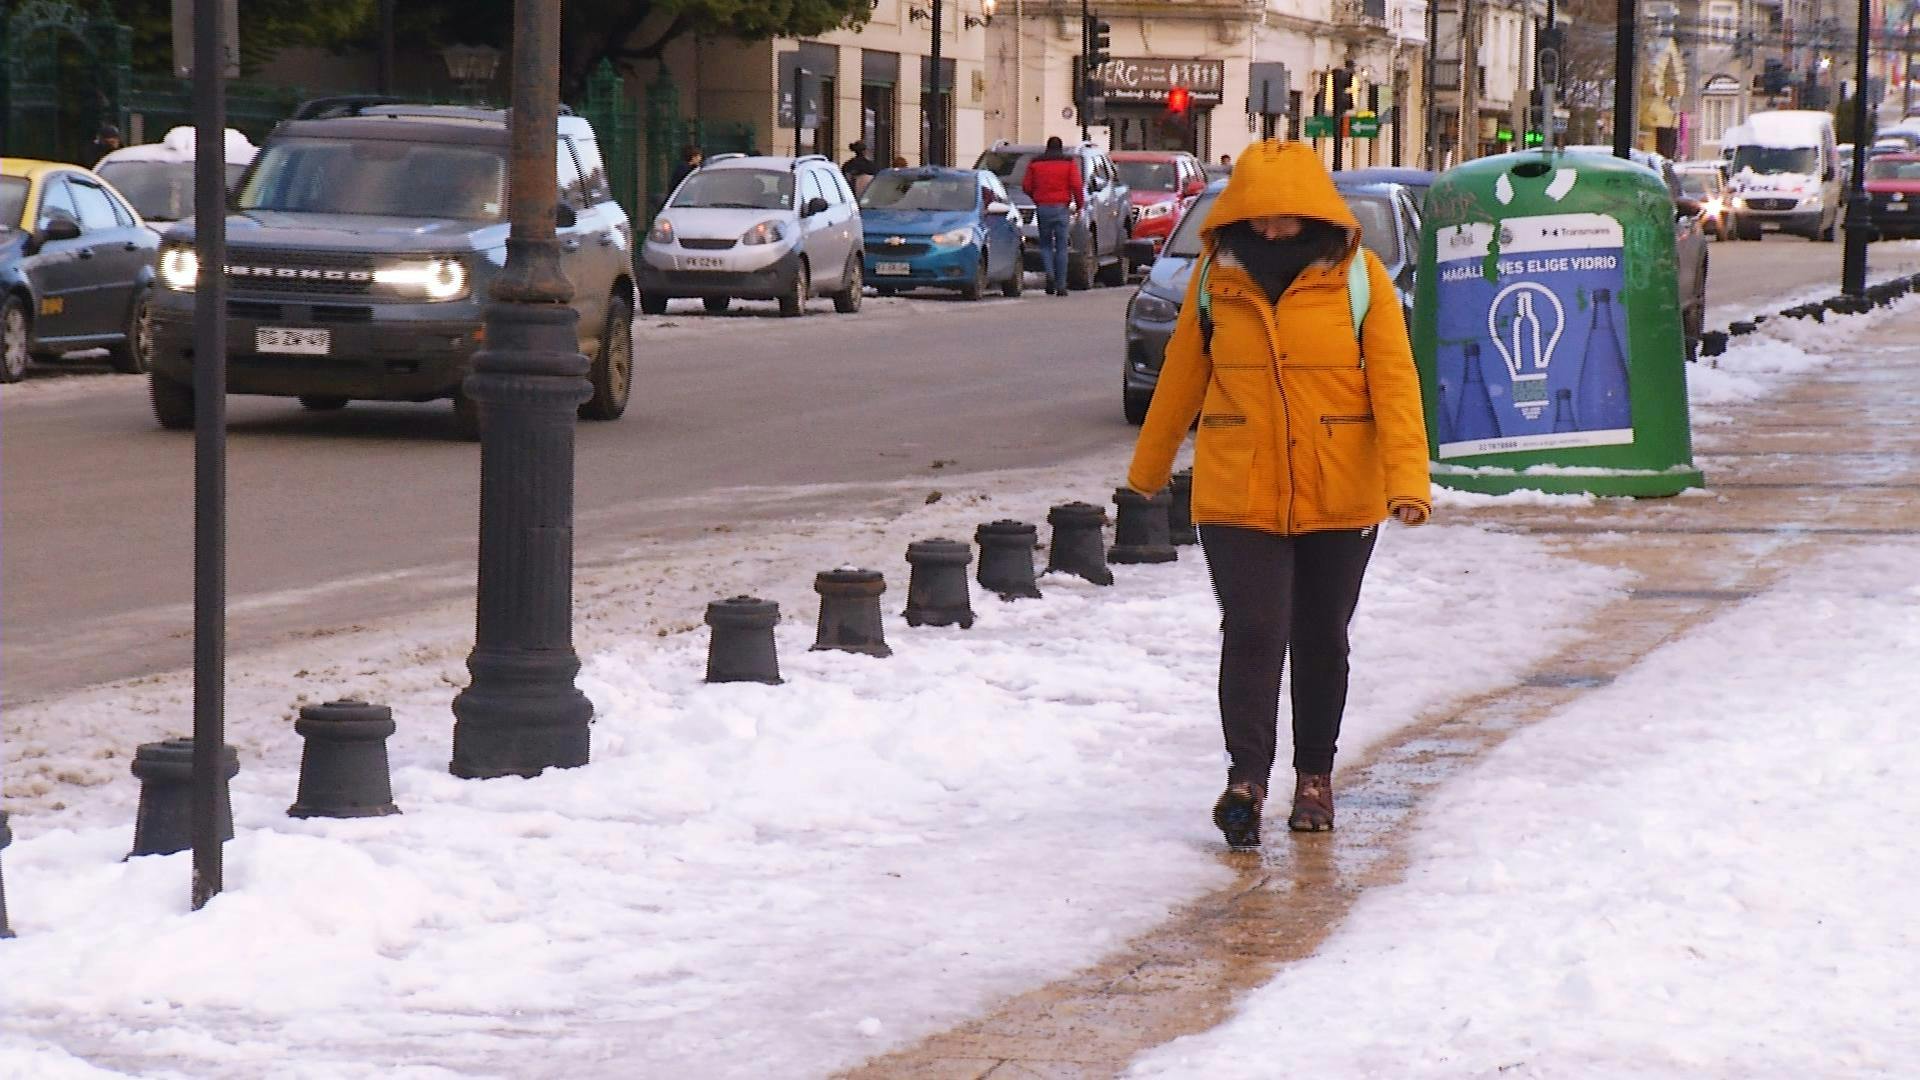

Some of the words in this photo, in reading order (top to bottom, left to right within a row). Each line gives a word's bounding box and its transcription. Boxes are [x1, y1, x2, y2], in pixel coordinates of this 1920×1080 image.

[1527, 258, 1568, 273] ELIGE
[1570, 255, 1617, 270] VIDRIO
[229, 266, 371, 280] BRONCO
